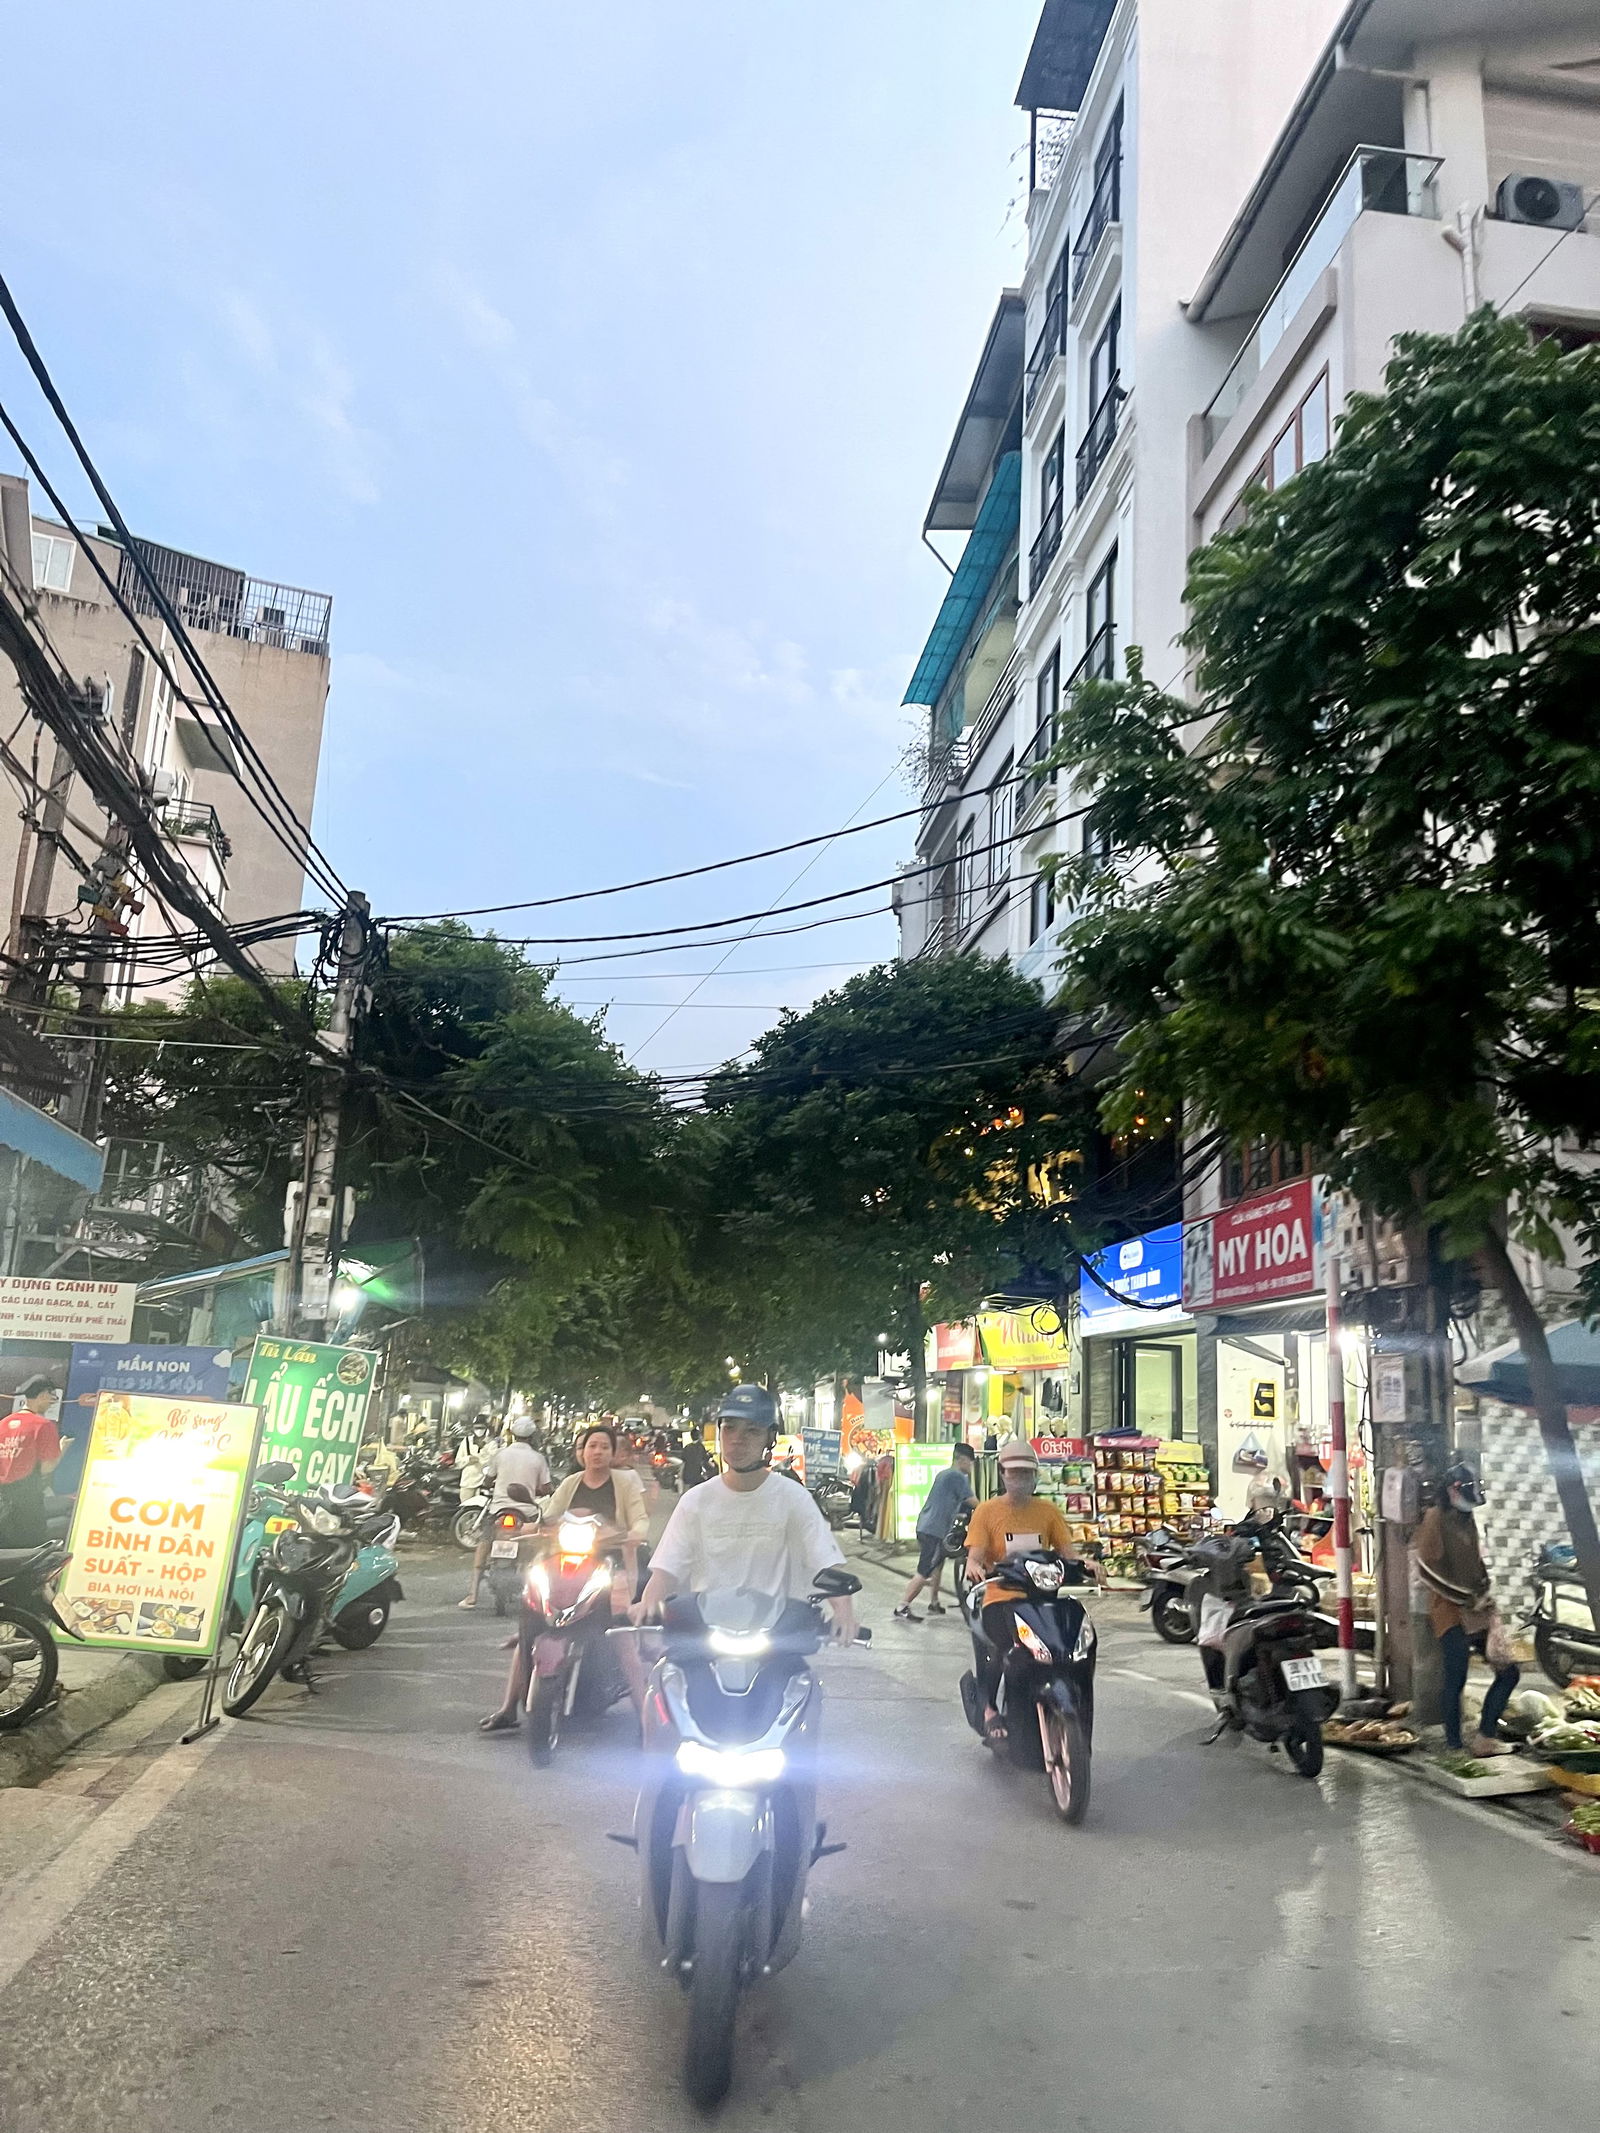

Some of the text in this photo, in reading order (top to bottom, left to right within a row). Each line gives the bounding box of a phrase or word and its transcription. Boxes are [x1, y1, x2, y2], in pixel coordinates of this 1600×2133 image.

[1218, 1233, 1250, 1278] MY
[1255, 1218, 1308, 1270] HOA
[156, 1361, 190, 1373] NON
[302, 1373, 366, 1444] ẾCH
[1041, 1439, 1073, 1455] Oishi
[305, 1450, 353, 1485] CAY
[110, 1497, 205, 1530] CƠM
[86, 1526, 215, 1558] BÌNH DÂN
[84, 1555, 142, 1577] SUẤT
[160, 1562, 207, 1585] HỘP
[88, 1582, 194, 1602] BIA HƠI HÀ NỘI
